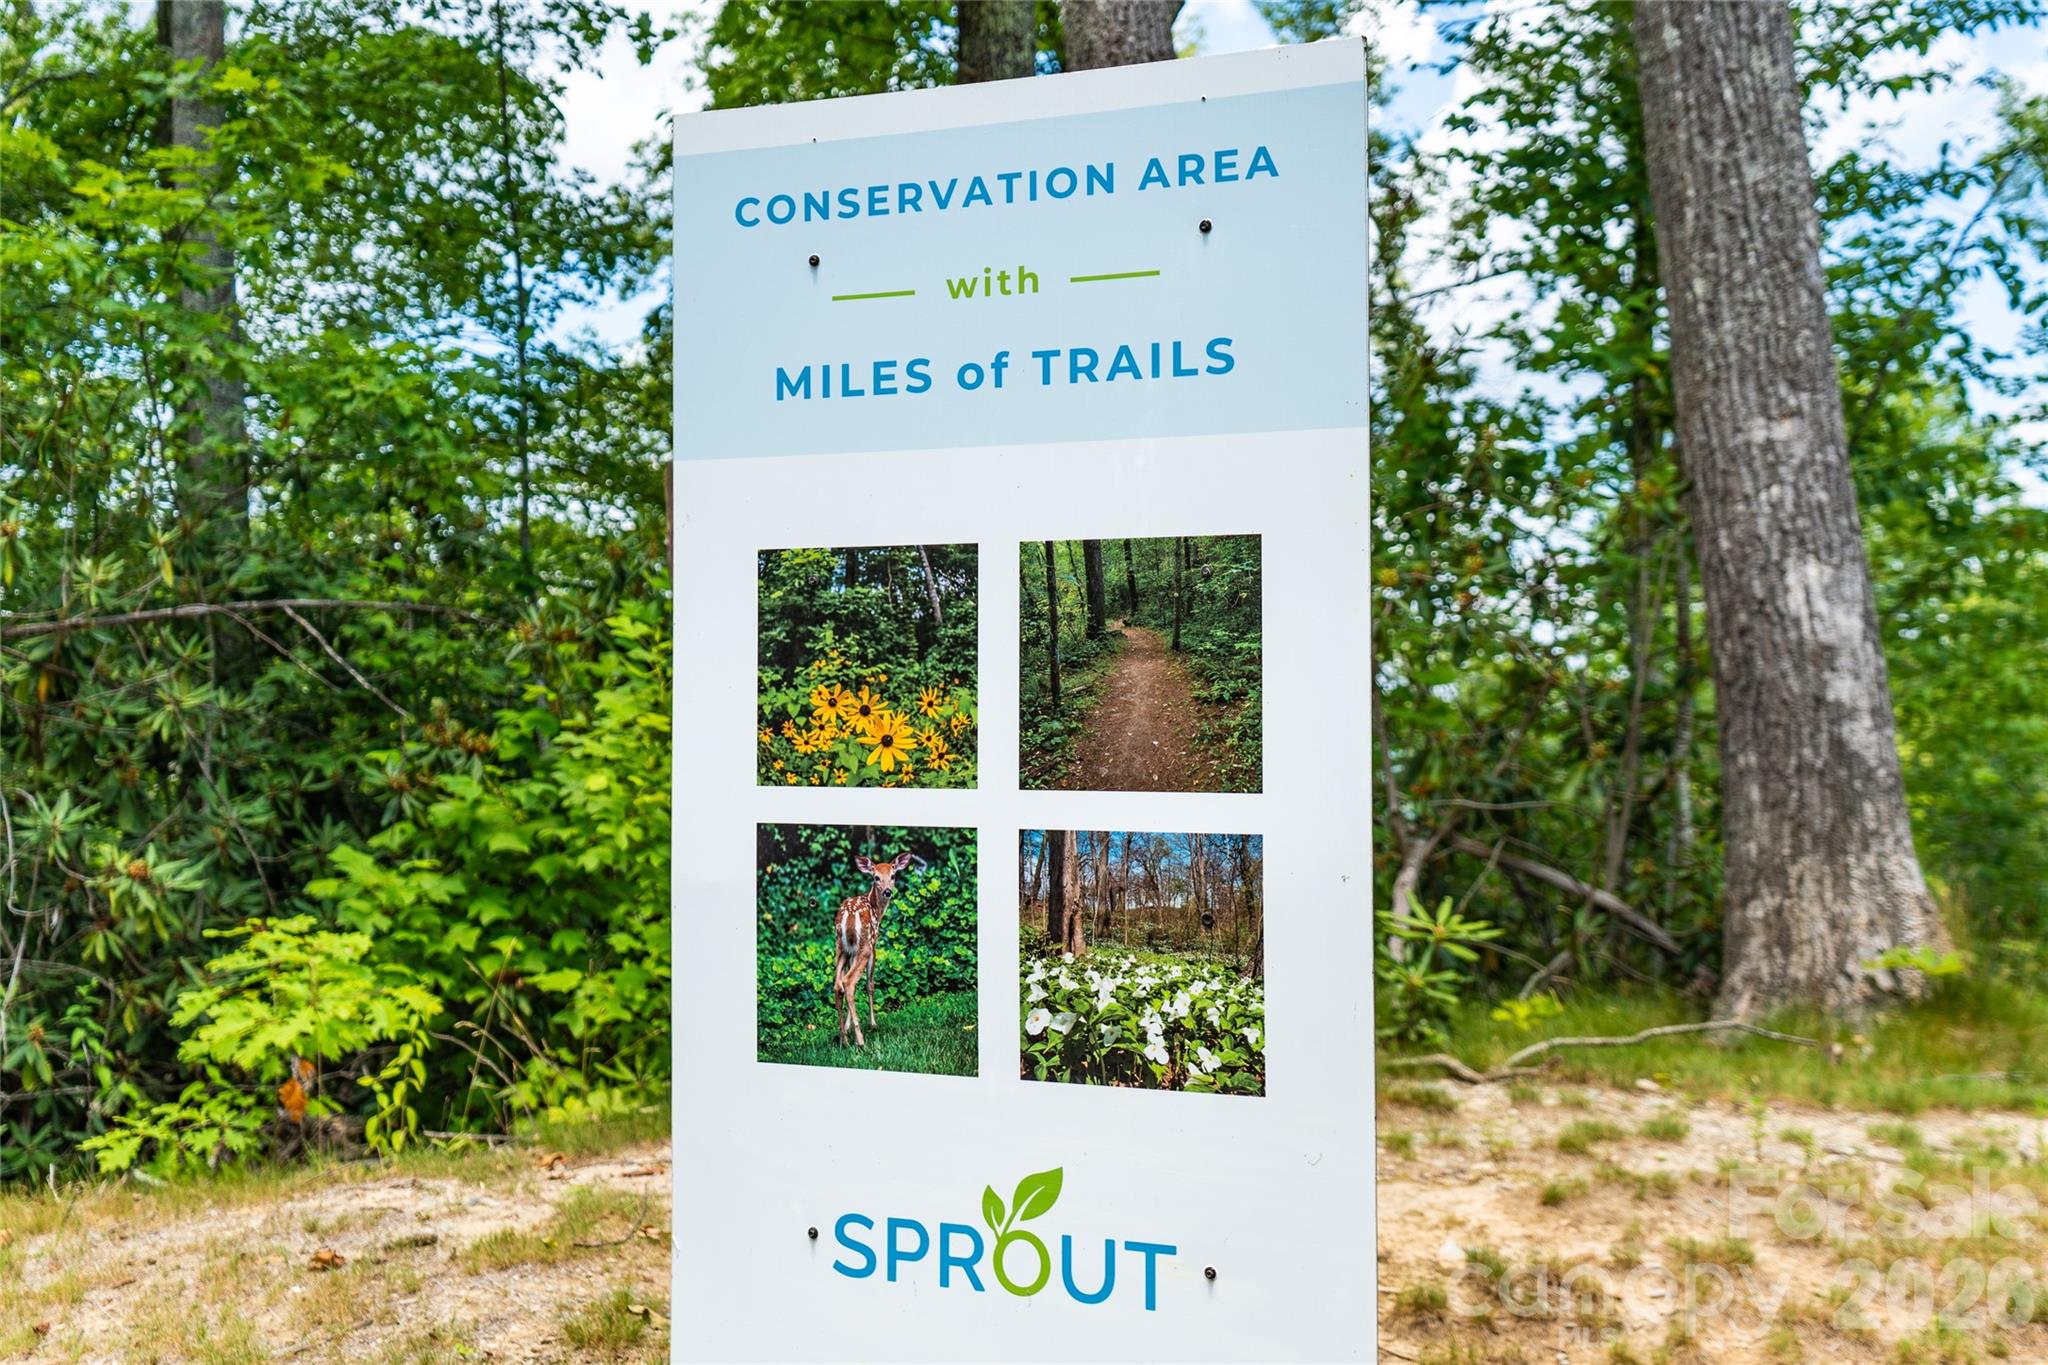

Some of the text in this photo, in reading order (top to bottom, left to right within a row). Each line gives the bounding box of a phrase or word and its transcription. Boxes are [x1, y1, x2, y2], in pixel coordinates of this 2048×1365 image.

[735, 145, 1280, 228] CONSERVATION AREA
[946, 266, 1040, 299] with
[775, 337, 1236, 401] MILES of TRAILS
[832, 1212, 1178, 1312] SPROUT
